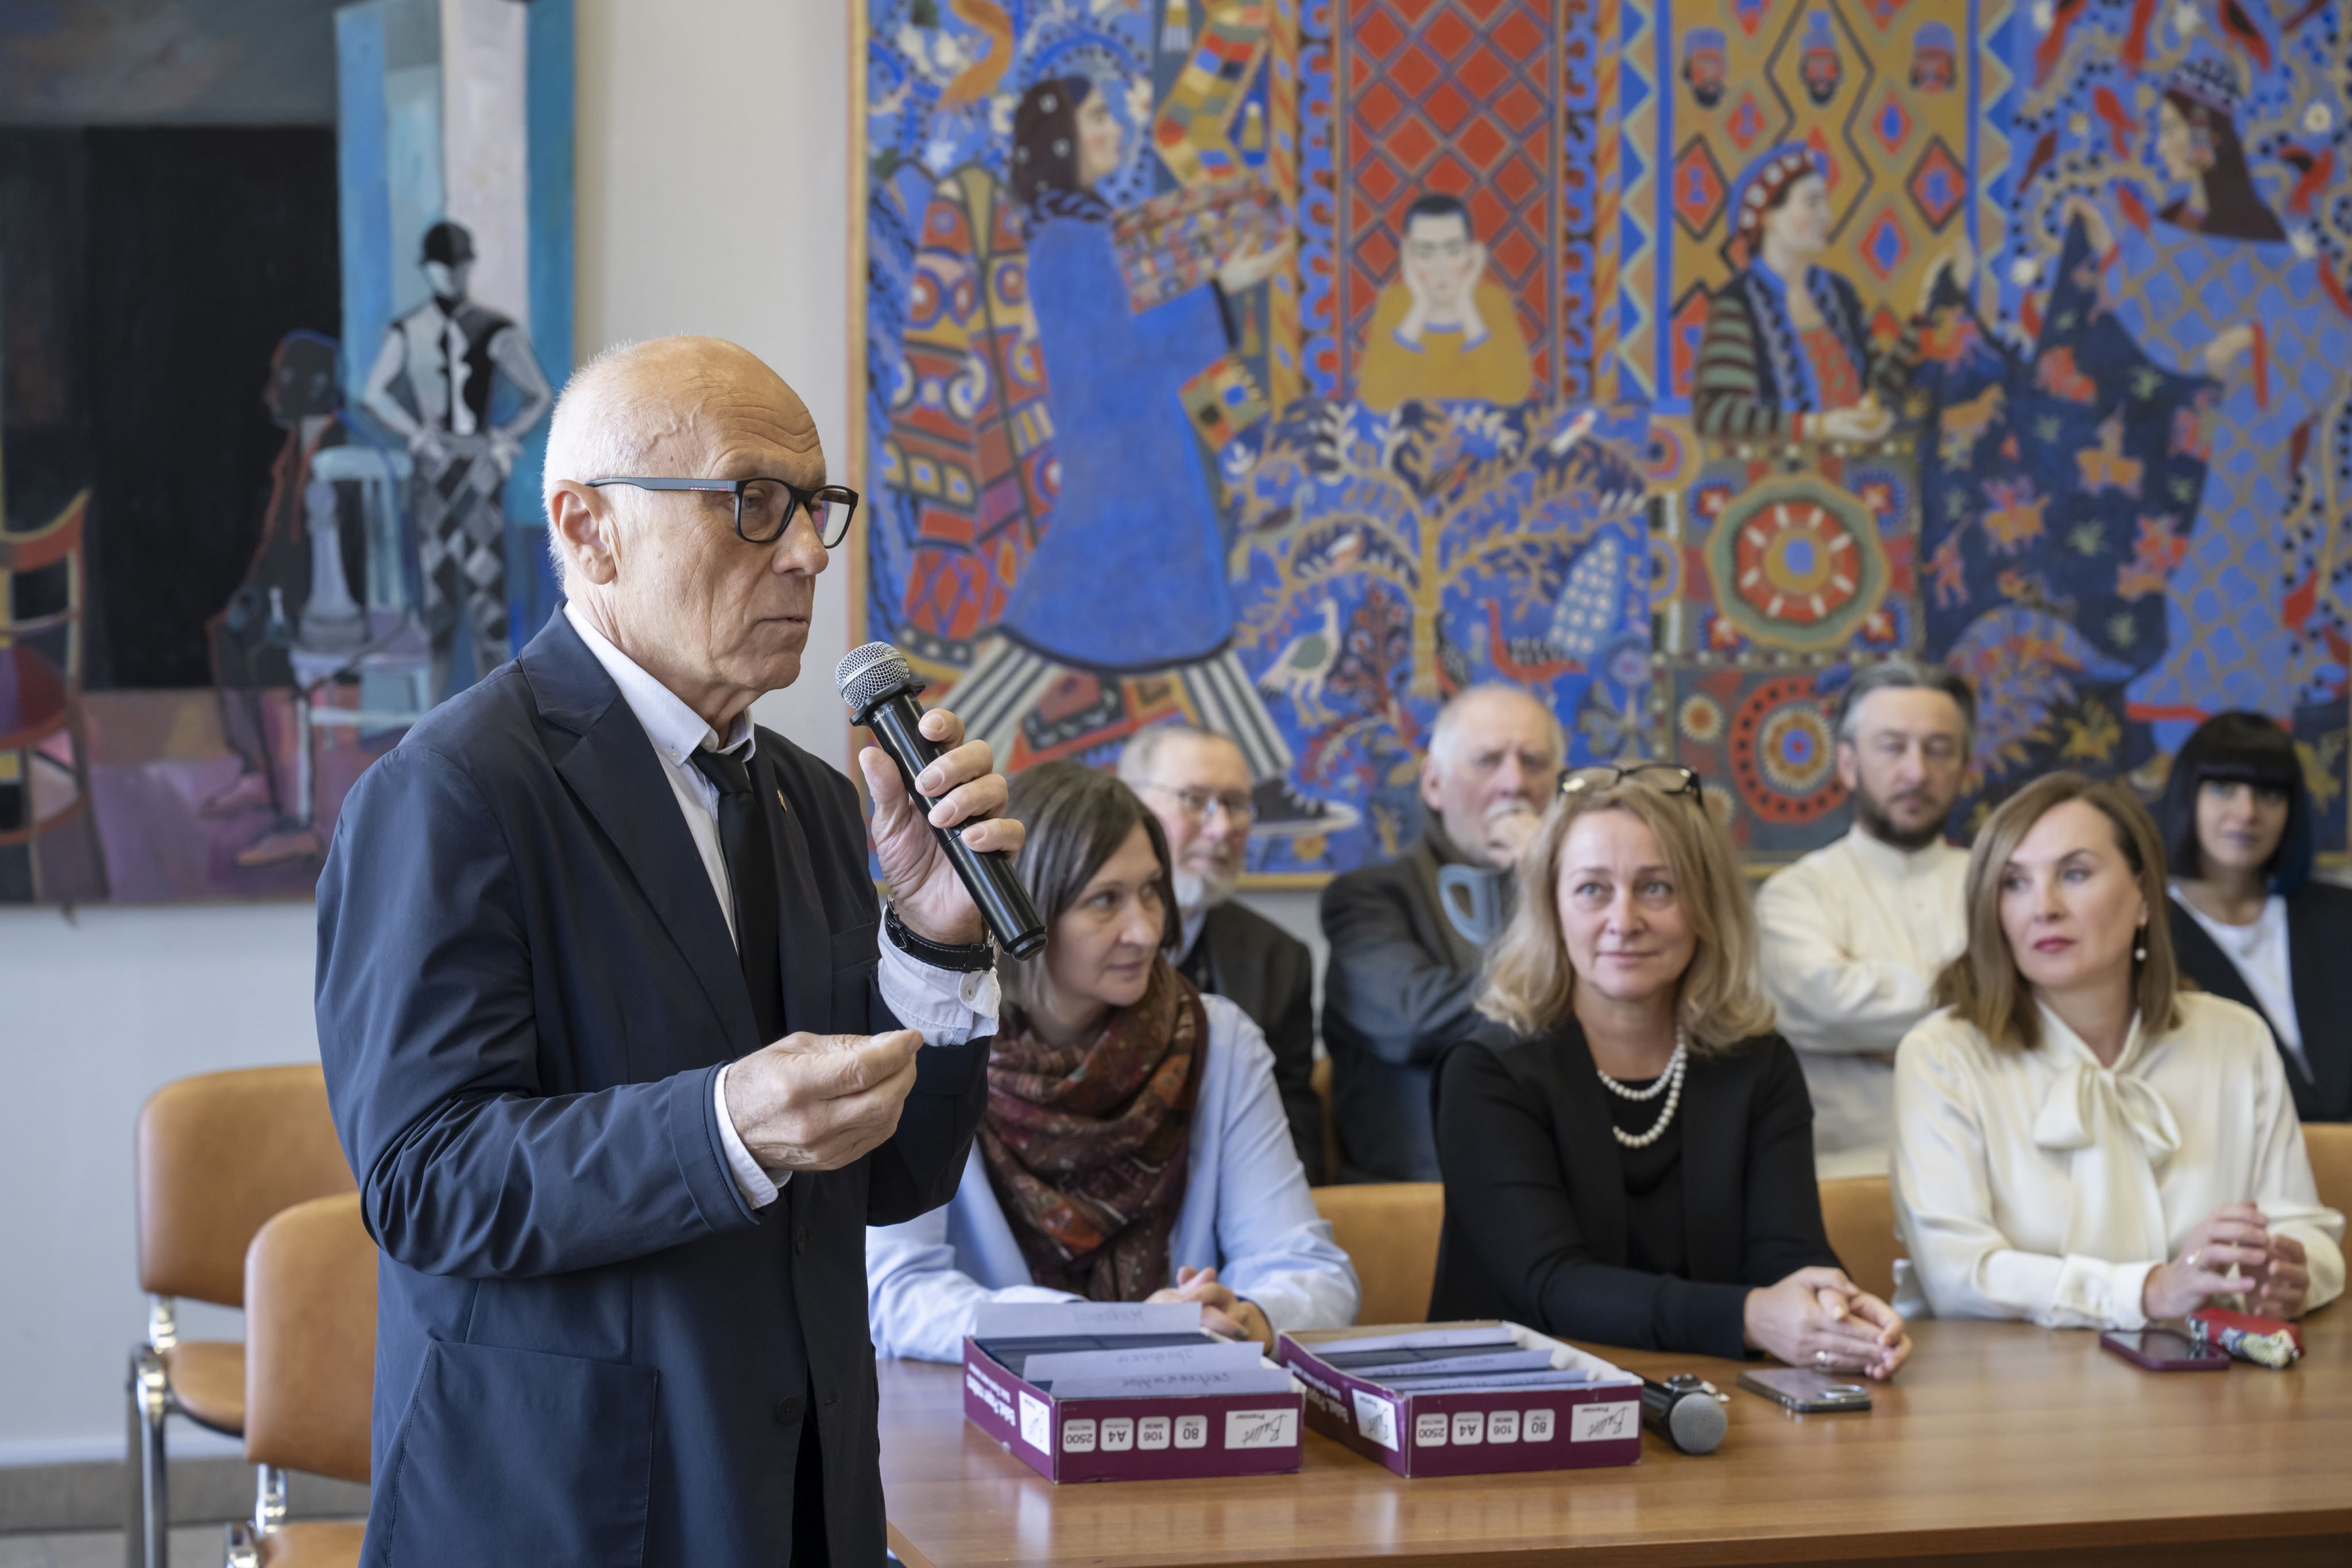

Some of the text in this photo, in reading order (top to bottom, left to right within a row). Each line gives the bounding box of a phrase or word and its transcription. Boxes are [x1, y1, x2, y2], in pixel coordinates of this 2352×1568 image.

[1531, 1421, 1547, 1434] 80
[1587, 1406, 1630, 1438] Ballet
[1144, 1430, 1163, 1441] 106
[1183, 1427, 1199, 1440] 80
[1240, 1414, 1288, 1446] Ballet
[1418, 1427, 1445, 1438] 2500
[1459, 1424, 1477, 1437] A4
[1494, 1424, 1512, 1435] 106
[1066, 1434, 1093, 1443] 2500
[1108, 1431, 1126, 1442] A4
